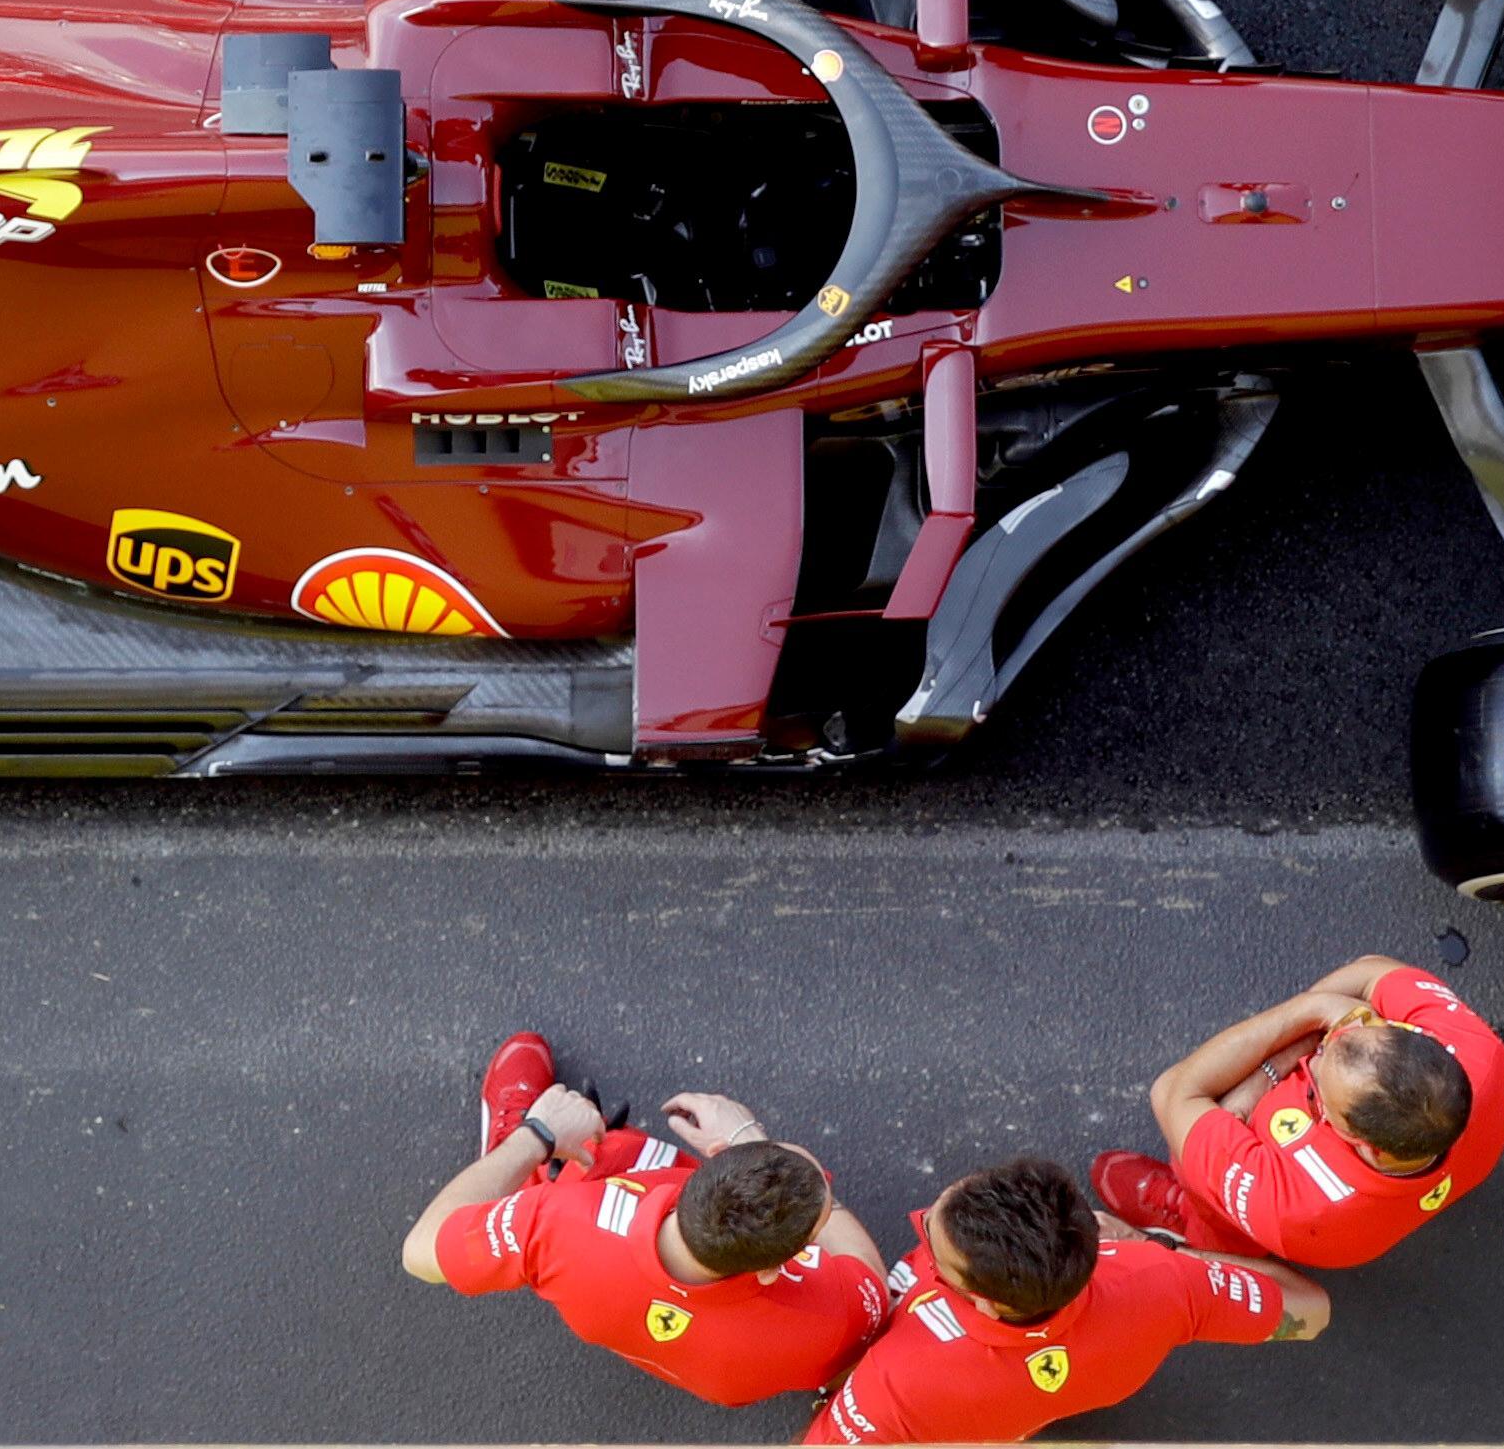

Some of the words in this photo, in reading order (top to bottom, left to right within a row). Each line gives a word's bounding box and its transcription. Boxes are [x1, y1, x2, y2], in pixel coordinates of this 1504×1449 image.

[845, 319, 893, 348] LOT
[688, 348, 783, 395] kaspersky
[116, 535, 227, 599] ups
[501, 1190, 524, 1254] UBLOT
